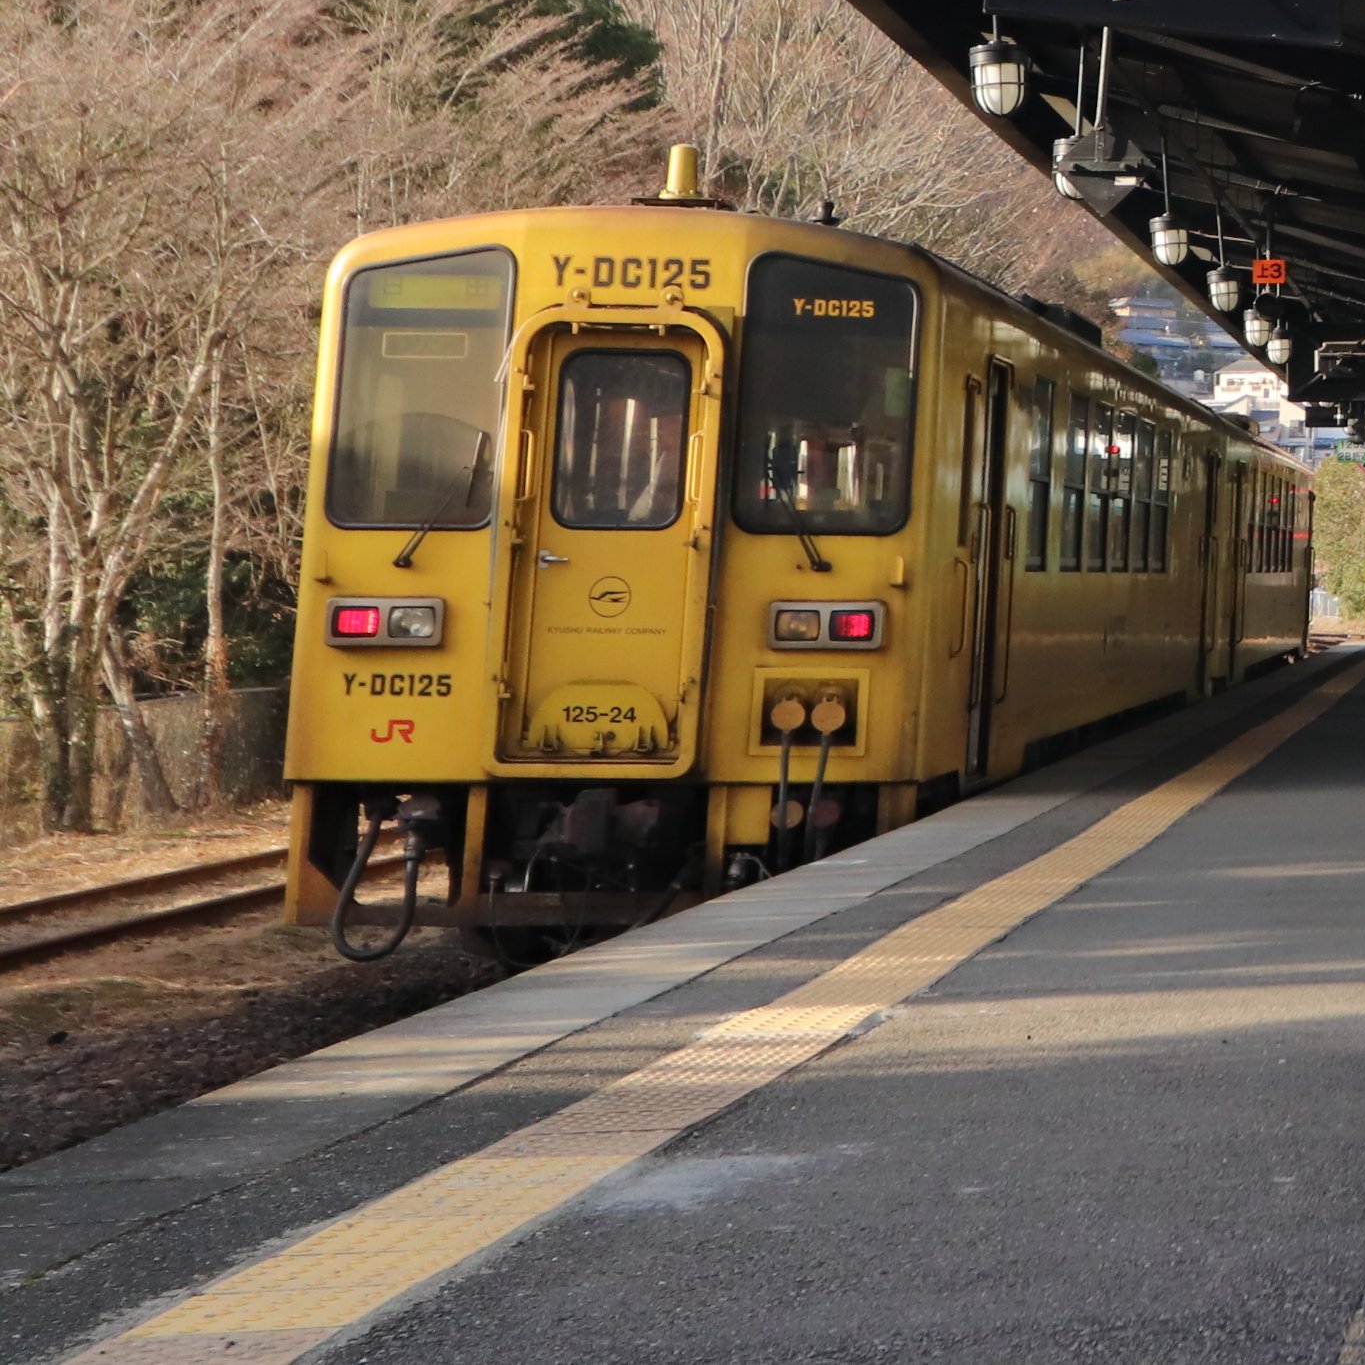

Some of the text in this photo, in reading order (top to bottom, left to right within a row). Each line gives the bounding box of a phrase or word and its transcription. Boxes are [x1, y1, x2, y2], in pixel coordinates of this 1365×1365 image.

[552, 256, 711, 290] Y-DC125
[1256, 263, 1282, 279] 上3
[793, 298, 875, 318] Y-DC125
[343, 673, 451, 697] Y-DC125
[562, 706, 637, 723] 125-24
[370, 719, 415, 744] JR
